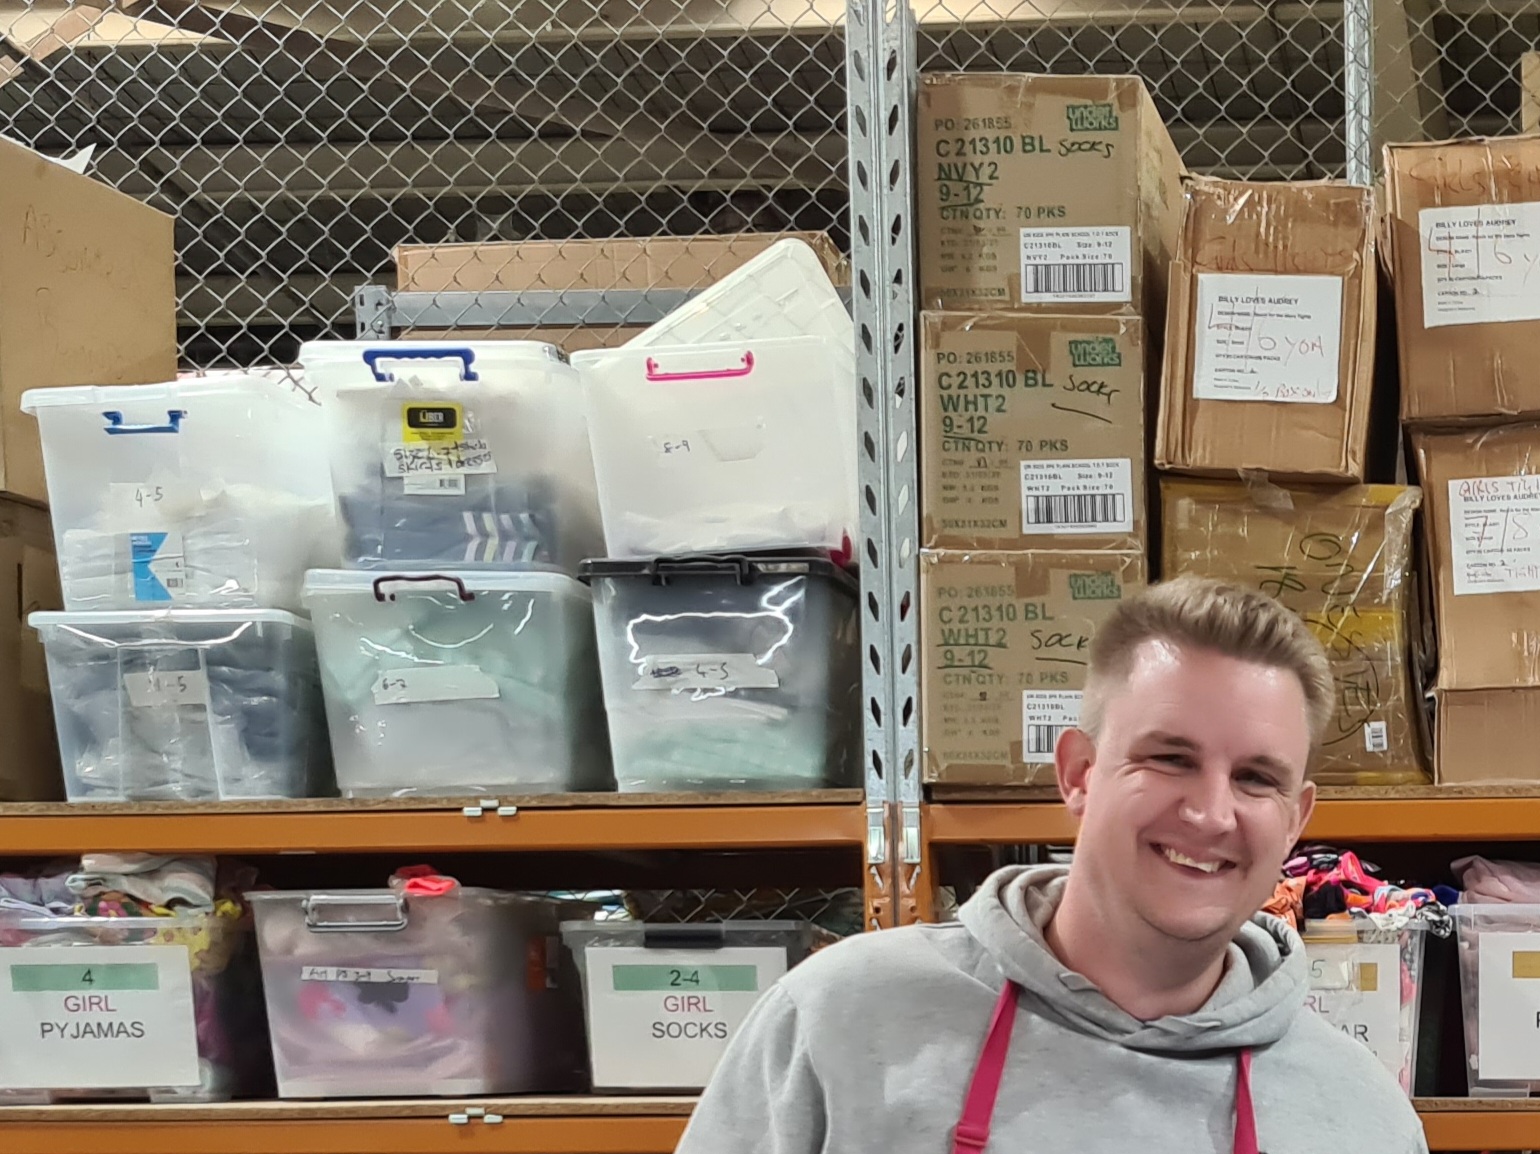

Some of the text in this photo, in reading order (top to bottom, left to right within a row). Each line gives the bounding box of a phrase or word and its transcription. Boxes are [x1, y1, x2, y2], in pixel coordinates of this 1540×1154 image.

[1022, 134, 1051, 154] BL
[937, 162, 999, 181] NVY2
[939, 184, 983, 202] 9-12
[1016, 207, 1031, 219] 70
[1038, 206, 1066, 218] PKS
[966, 352, 1014, 364] 261855
[1024, 370, 1053, 388] BL
[940, 394, 1006, 412] WHT2
[942, 415, 988, 434] 9-12
[942, 440, 1068, 452] CTN 70 PKS
[135, 486, 164, 507] 4-5
[1024, 603, 1054, 622] BL
[941, 628, 1007, 646] WHT2
[943, 650, 988, 668] 9-12
[1018, 672, 1032, 684] 70
[1040, 671, 1068, 684] PKS
[81, 968, 93, 985] 4
[669, 970, 700, 986] 2-4
[64, 995, 117, 1012] GIRL
[664, 996, 714, 1012] GIRL
[40, 1022, 145, 1039] PYJAMAS
[652, 1022, 727, 1039] SOCKS
